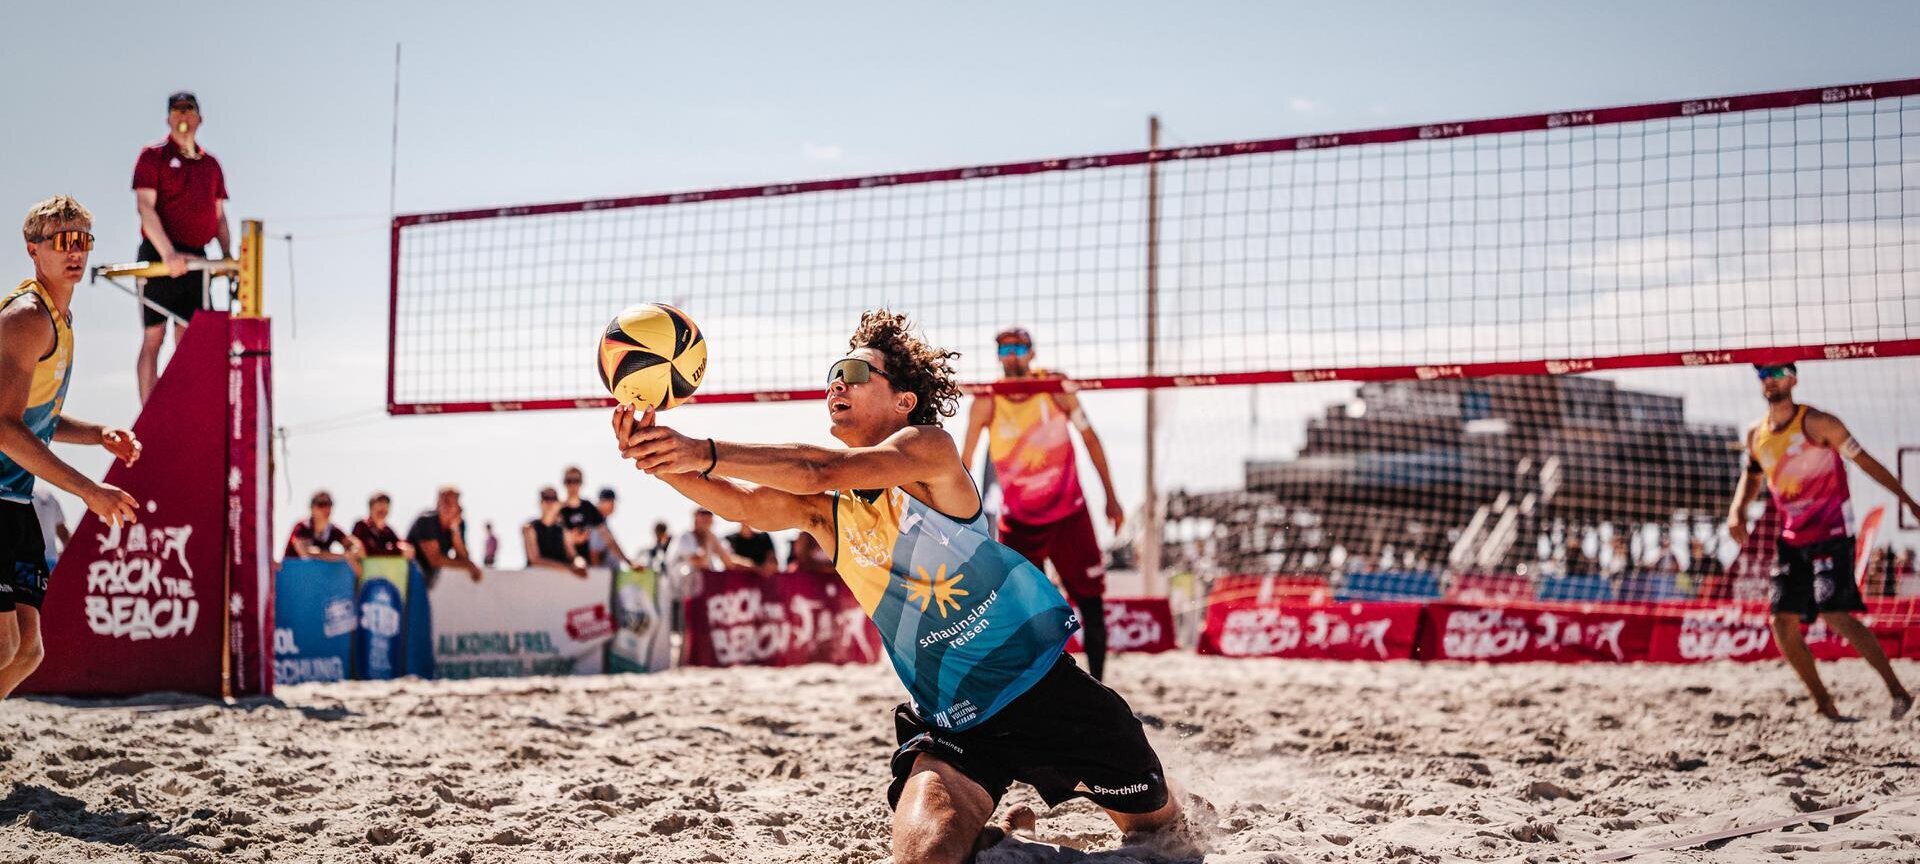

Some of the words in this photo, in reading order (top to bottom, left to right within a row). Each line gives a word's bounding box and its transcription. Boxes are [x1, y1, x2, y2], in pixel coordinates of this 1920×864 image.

[87, 557, 162, 596] ROCK
[162, 576, 196, 599] THE
[84, 595, 200, 641] BEACH
[919, 589, 998, 648] schauinsland
[948, 618, 990, 649] reisen
[937, 737, 964, 754] business
[1094, 783, 1149, 796] Sporthilfe
